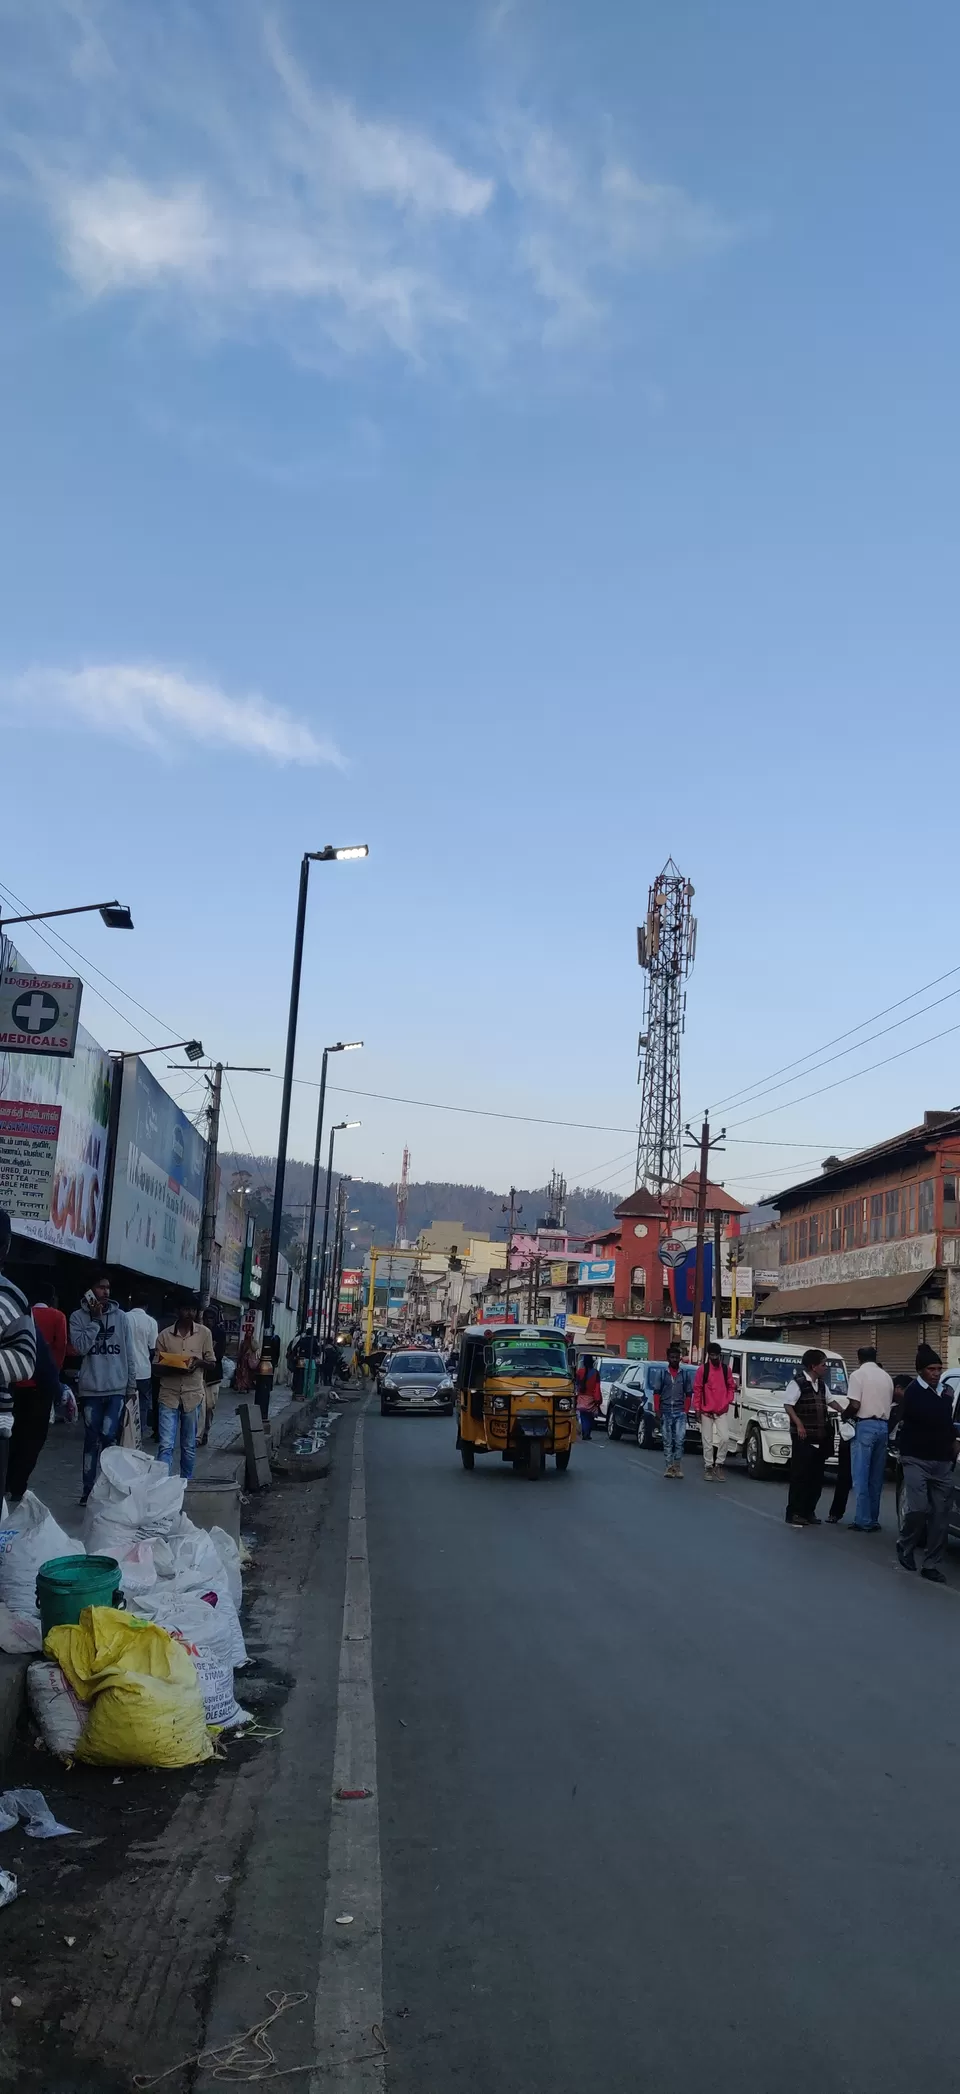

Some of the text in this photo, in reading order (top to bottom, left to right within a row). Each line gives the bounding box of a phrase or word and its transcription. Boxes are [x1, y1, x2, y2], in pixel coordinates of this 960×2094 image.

[4, 976, 74, 990] மருந்தகம்
[0, 1032, 68, 1048] MEDICALS
[32, 1125, 56, 1135] STORES
[23, 1169, 51, 1177] BUTTER,
[667, 1243, 681, 1252] HP
